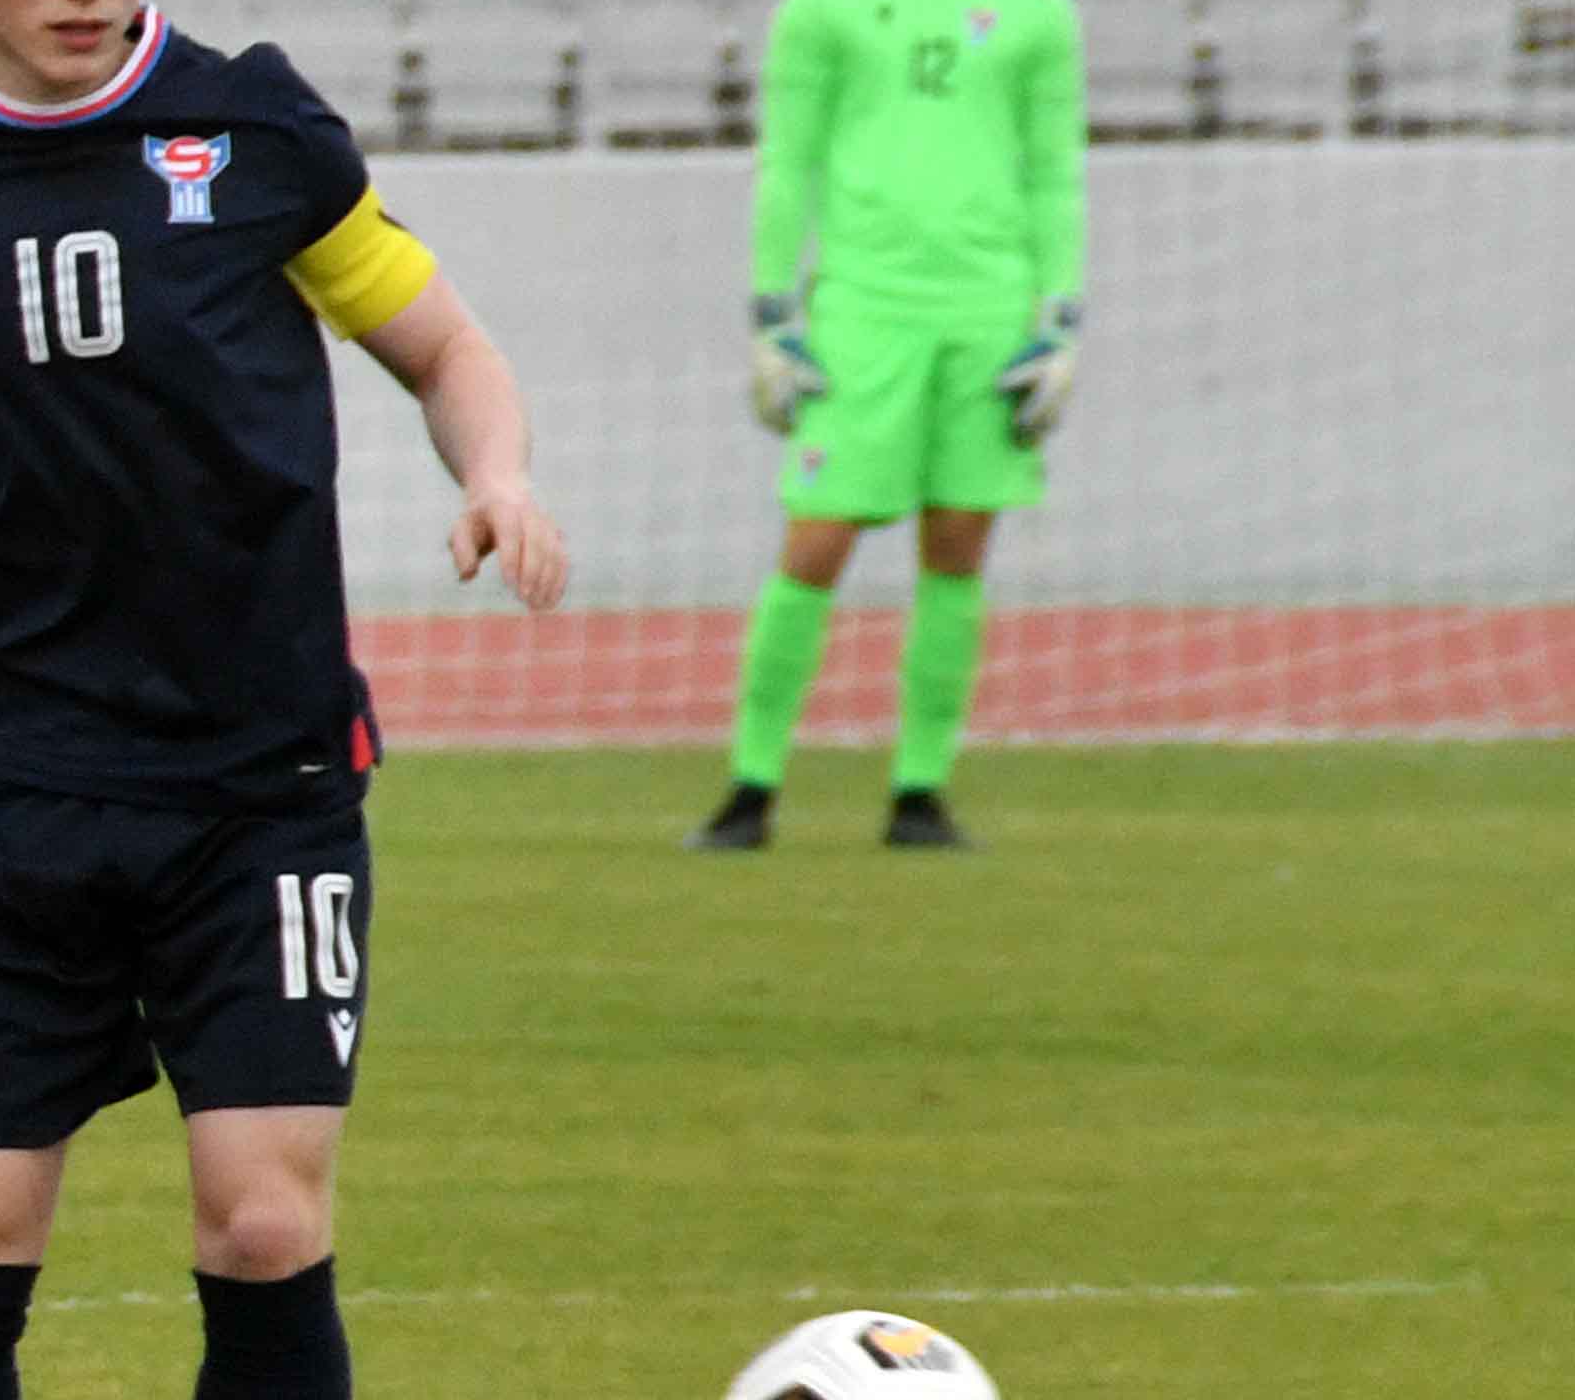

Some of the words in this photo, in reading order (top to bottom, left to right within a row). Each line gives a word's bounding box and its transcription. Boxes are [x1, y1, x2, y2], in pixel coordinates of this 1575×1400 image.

[907, 37, 955, 96] 12
[13, 230, 124, 364] 10
[276, 873, 358, 1001] 10
